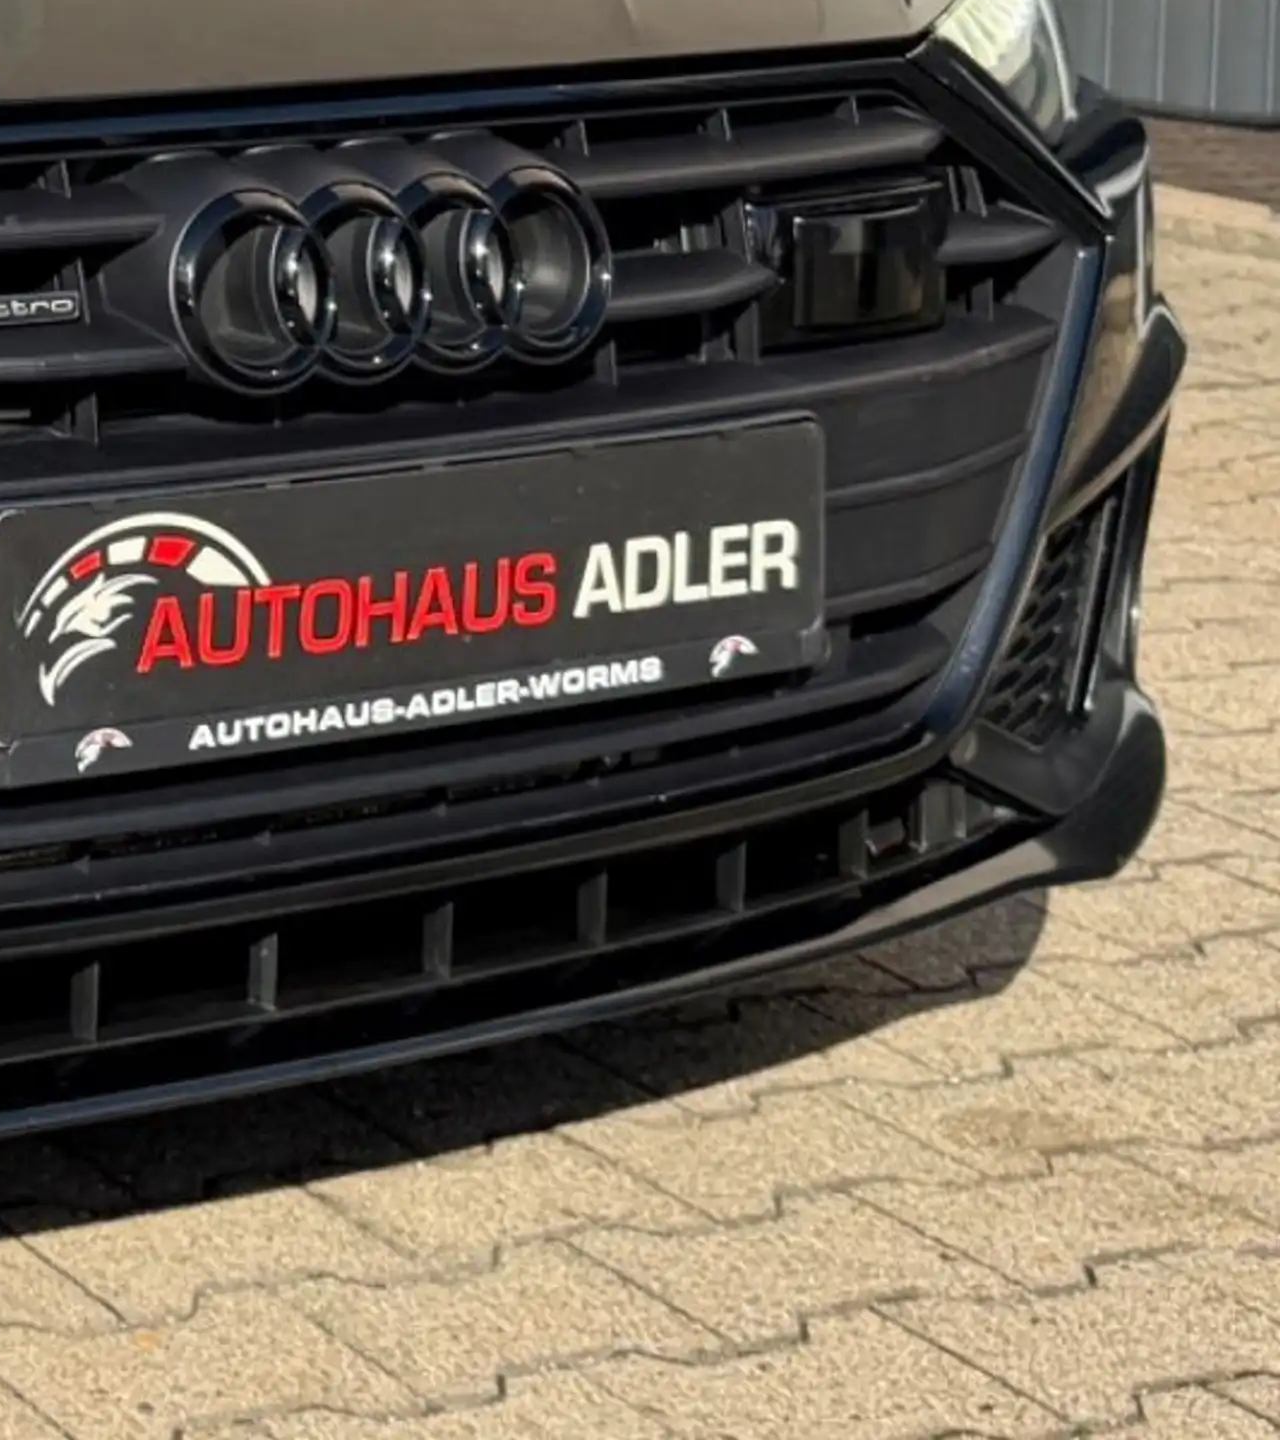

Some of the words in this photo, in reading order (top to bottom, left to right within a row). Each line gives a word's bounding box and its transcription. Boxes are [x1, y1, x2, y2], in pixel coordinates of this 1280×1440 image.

[136, 552, 559, 673] AUTOHAUS
[573, 517, 800, 620] ADLER
[187, 656, 663, 751] AUTOHAUS-ADLER-WORMS
